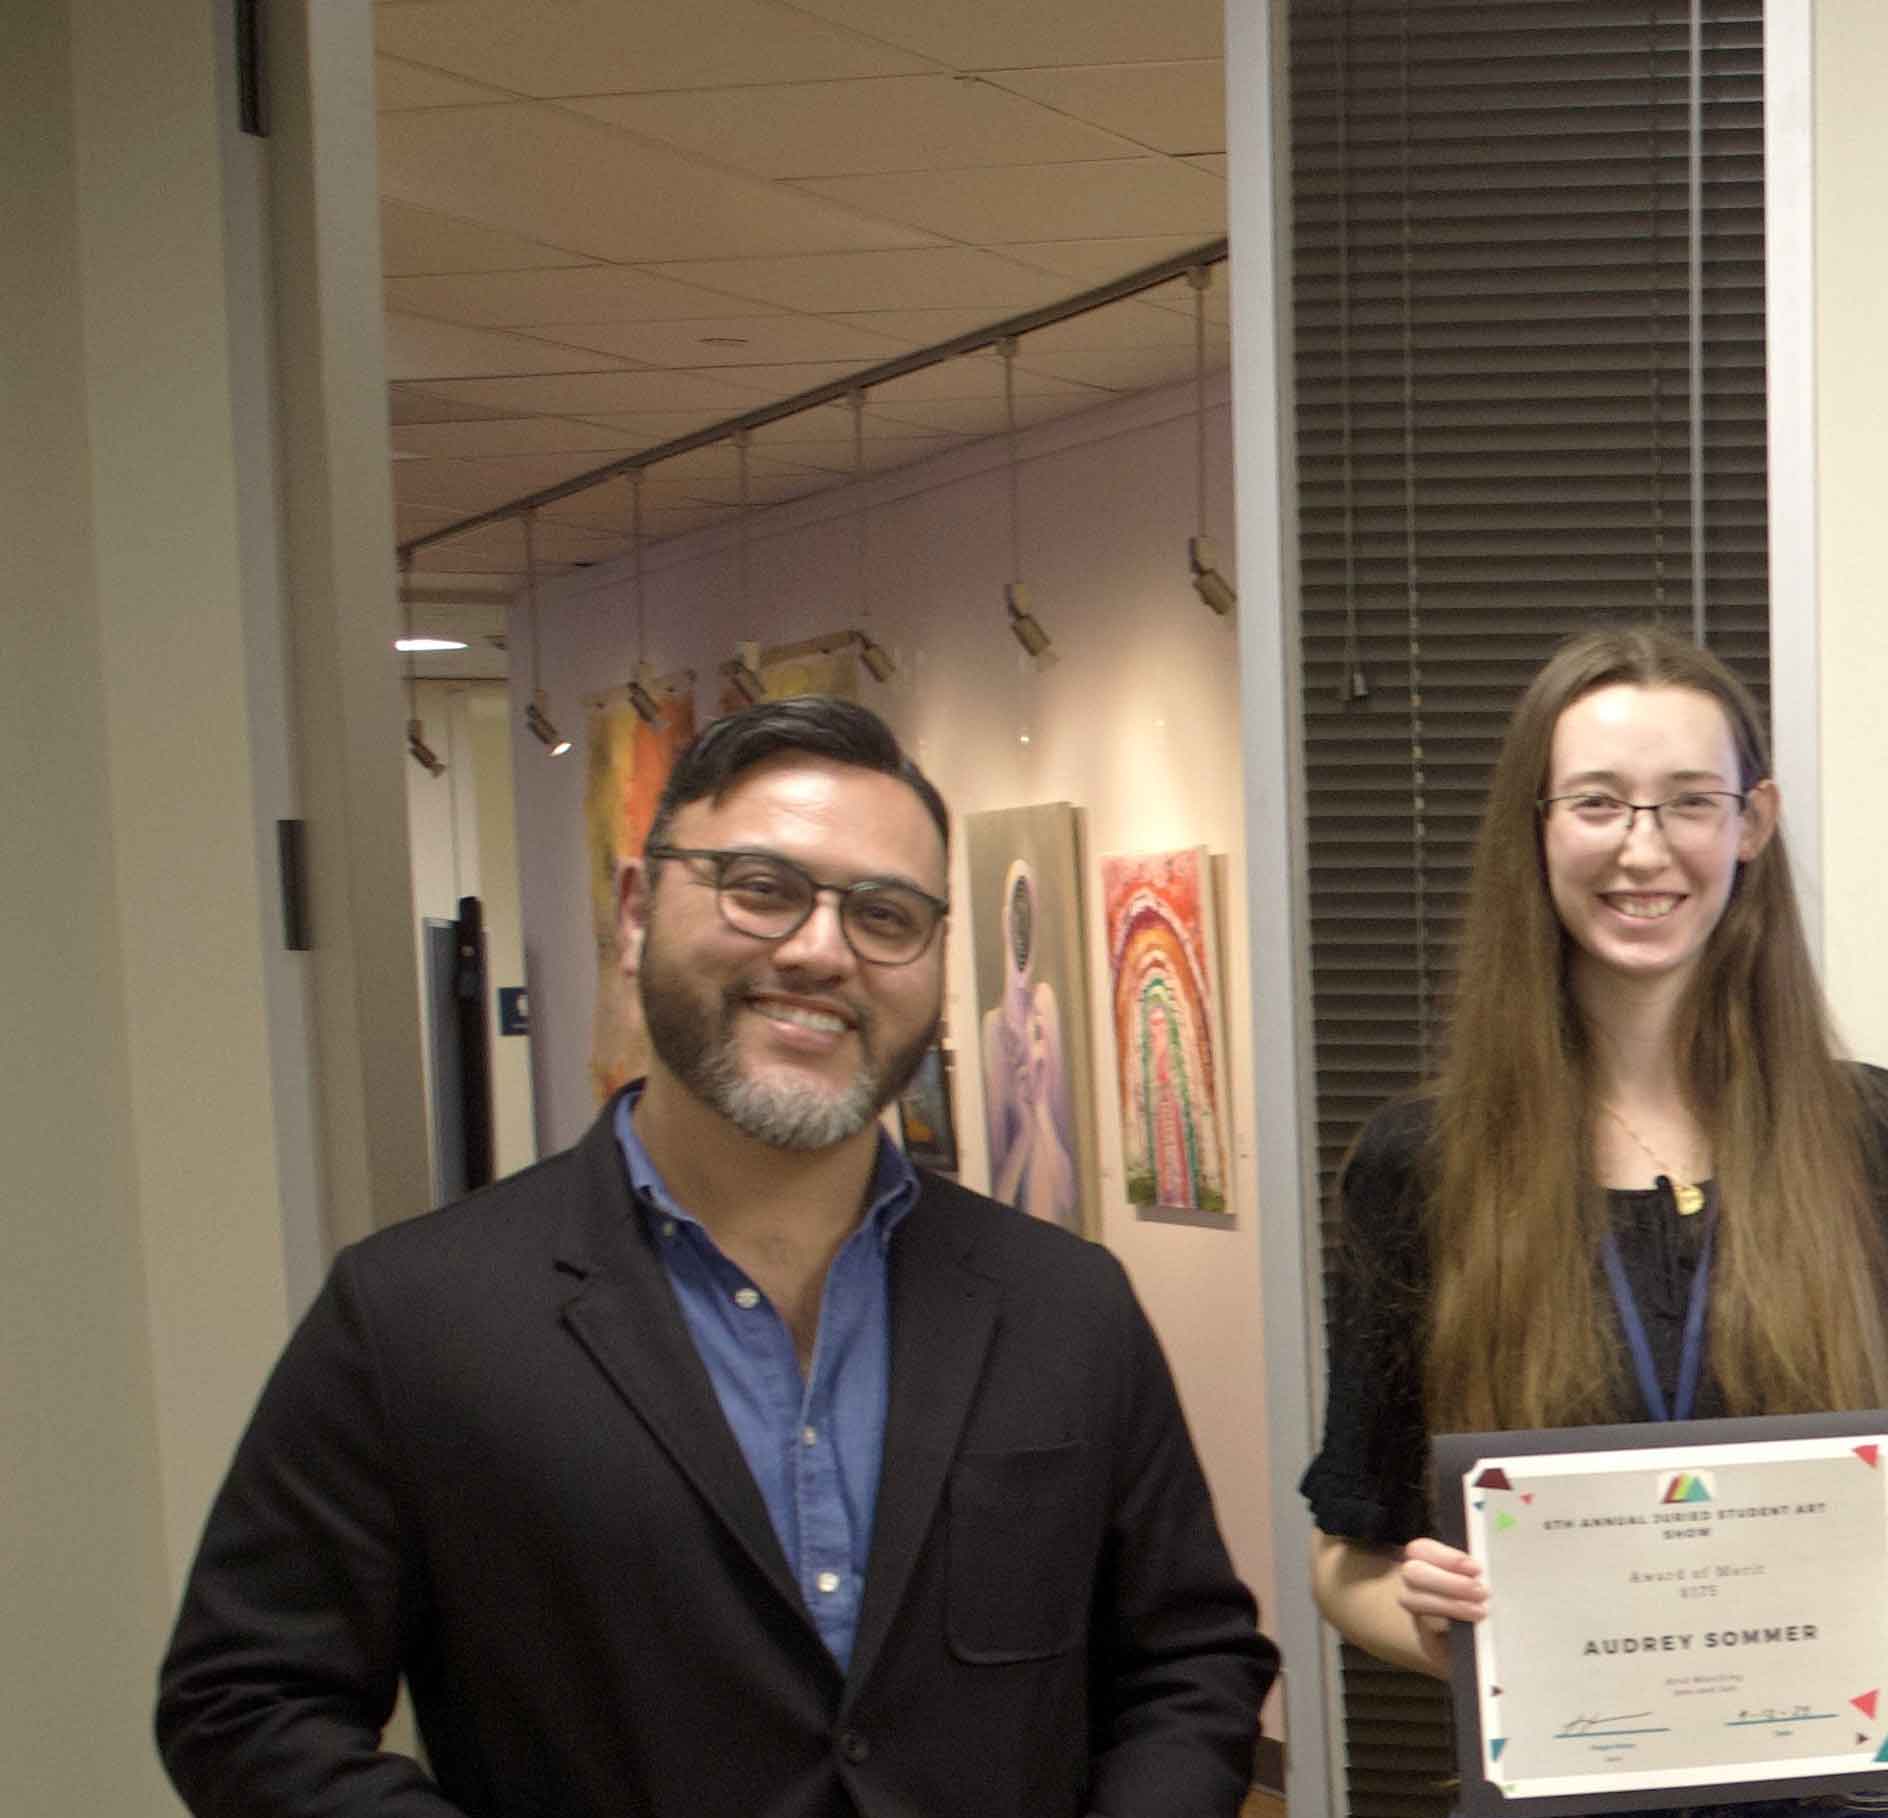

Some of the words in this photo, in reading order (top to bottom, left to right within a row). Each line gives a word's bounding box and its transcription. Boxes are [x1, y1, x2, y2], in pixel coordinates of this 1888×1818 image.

[1579, 1514, 1648, 1528] ANNUAL
[1653, 1510, 1712, 1524] JURIED
[1718, 1505, 1790, 1520] STUDENT
[1795, 1502, 1827, 1515] ART
[1663, 1527, 1711, 1540] SHOW
[1629, 1569, 1684, 1583] Award
[1692, 1568, 1709, 1580] of
[1716, 1564, 1766, 1578] Merit
[1583, 1633, 1694, 1656] AUDREY
[1704, 1624, 1819, 1648] SOMMER
